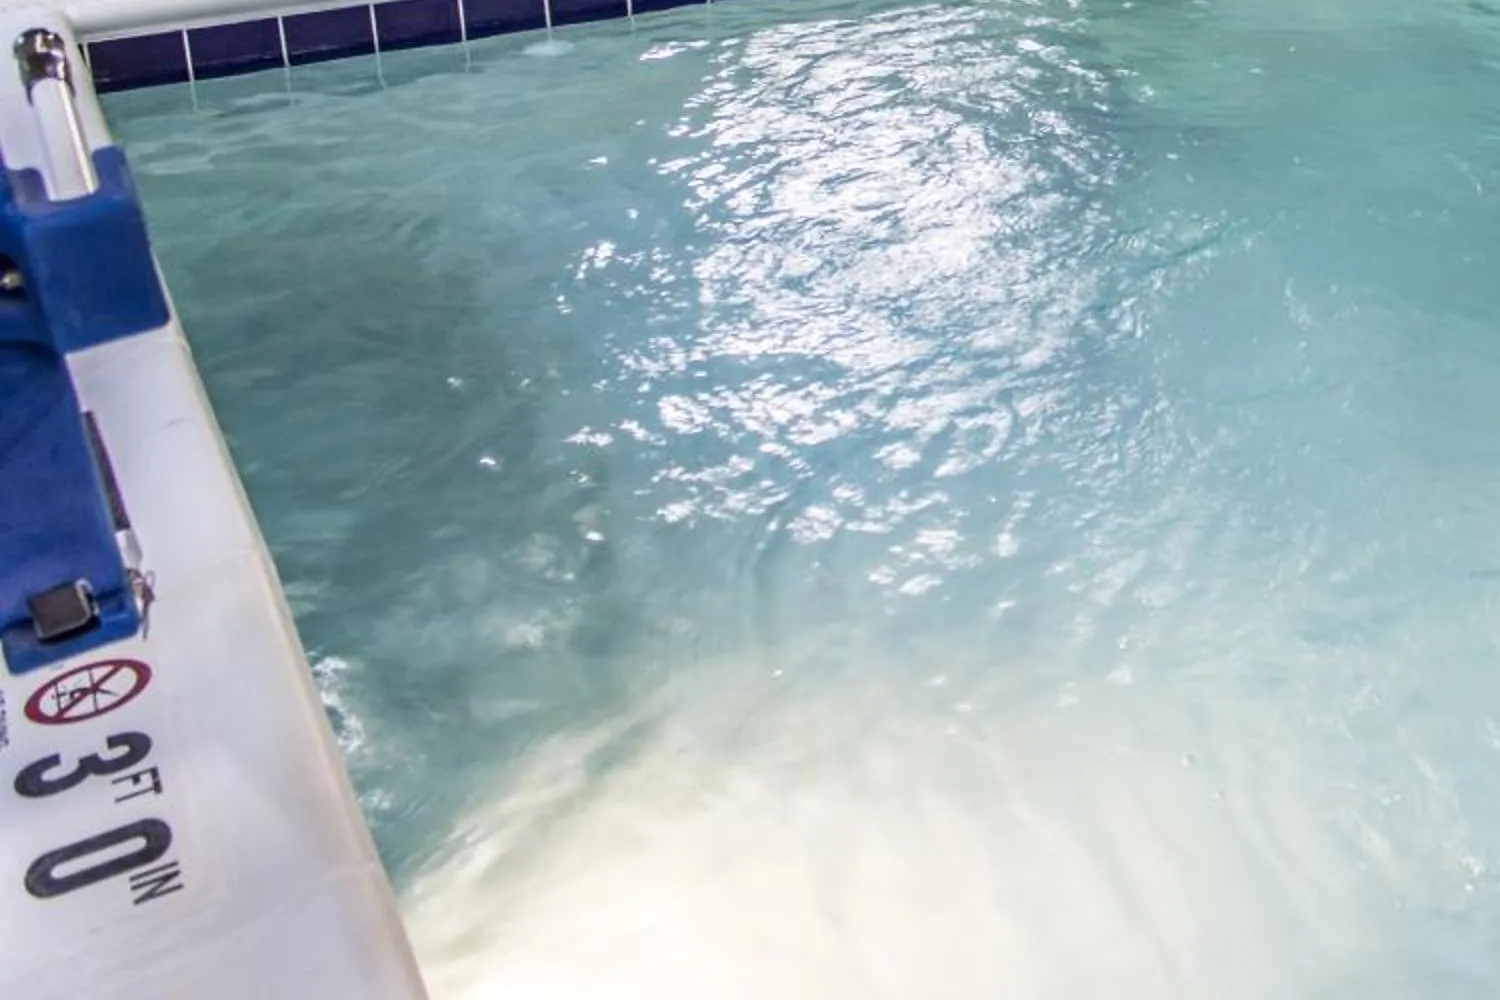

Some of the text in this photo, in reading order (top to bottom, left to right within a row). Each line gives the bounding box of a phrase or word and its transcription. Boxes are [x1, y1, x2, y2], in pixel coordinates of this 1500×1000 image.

[14, 731, 184, 906] 3 FT 0 IN
